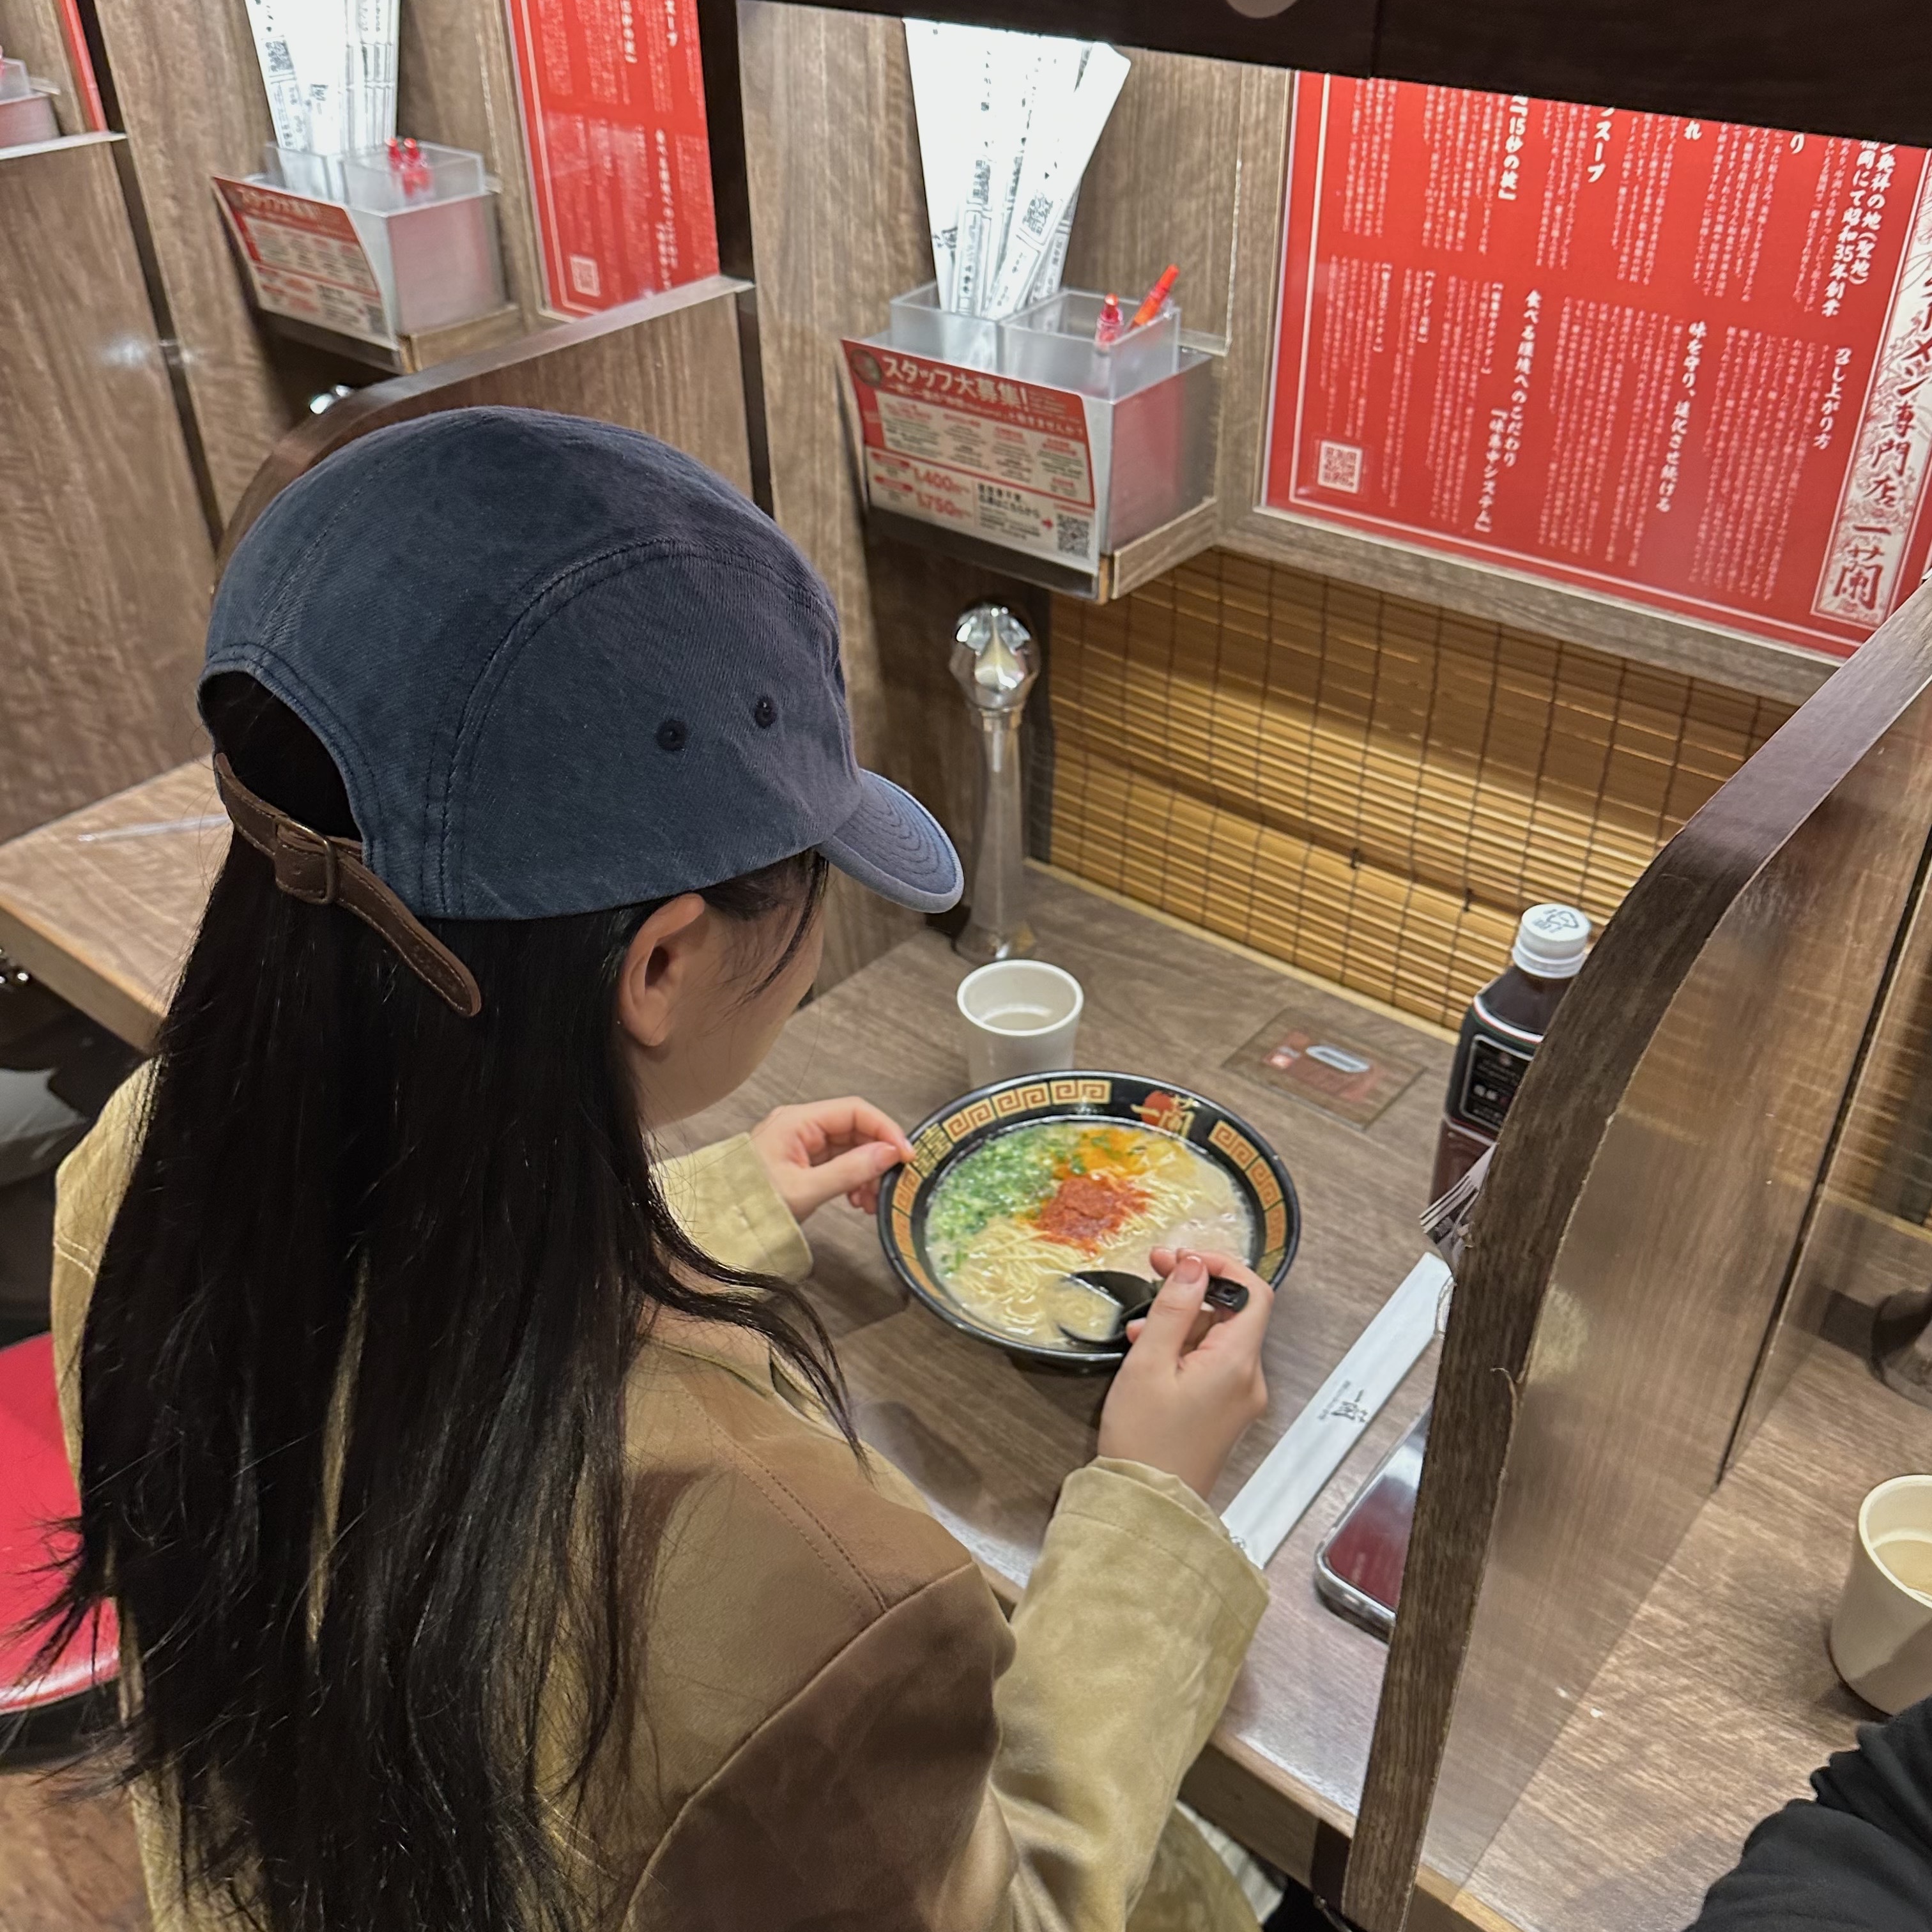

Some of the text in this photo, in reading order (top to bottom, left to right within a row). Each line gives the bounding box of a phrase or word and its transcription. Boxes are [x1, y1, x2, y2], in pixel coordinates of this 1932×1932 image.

[1814, 348, 1851, 449] 召し上がり方
